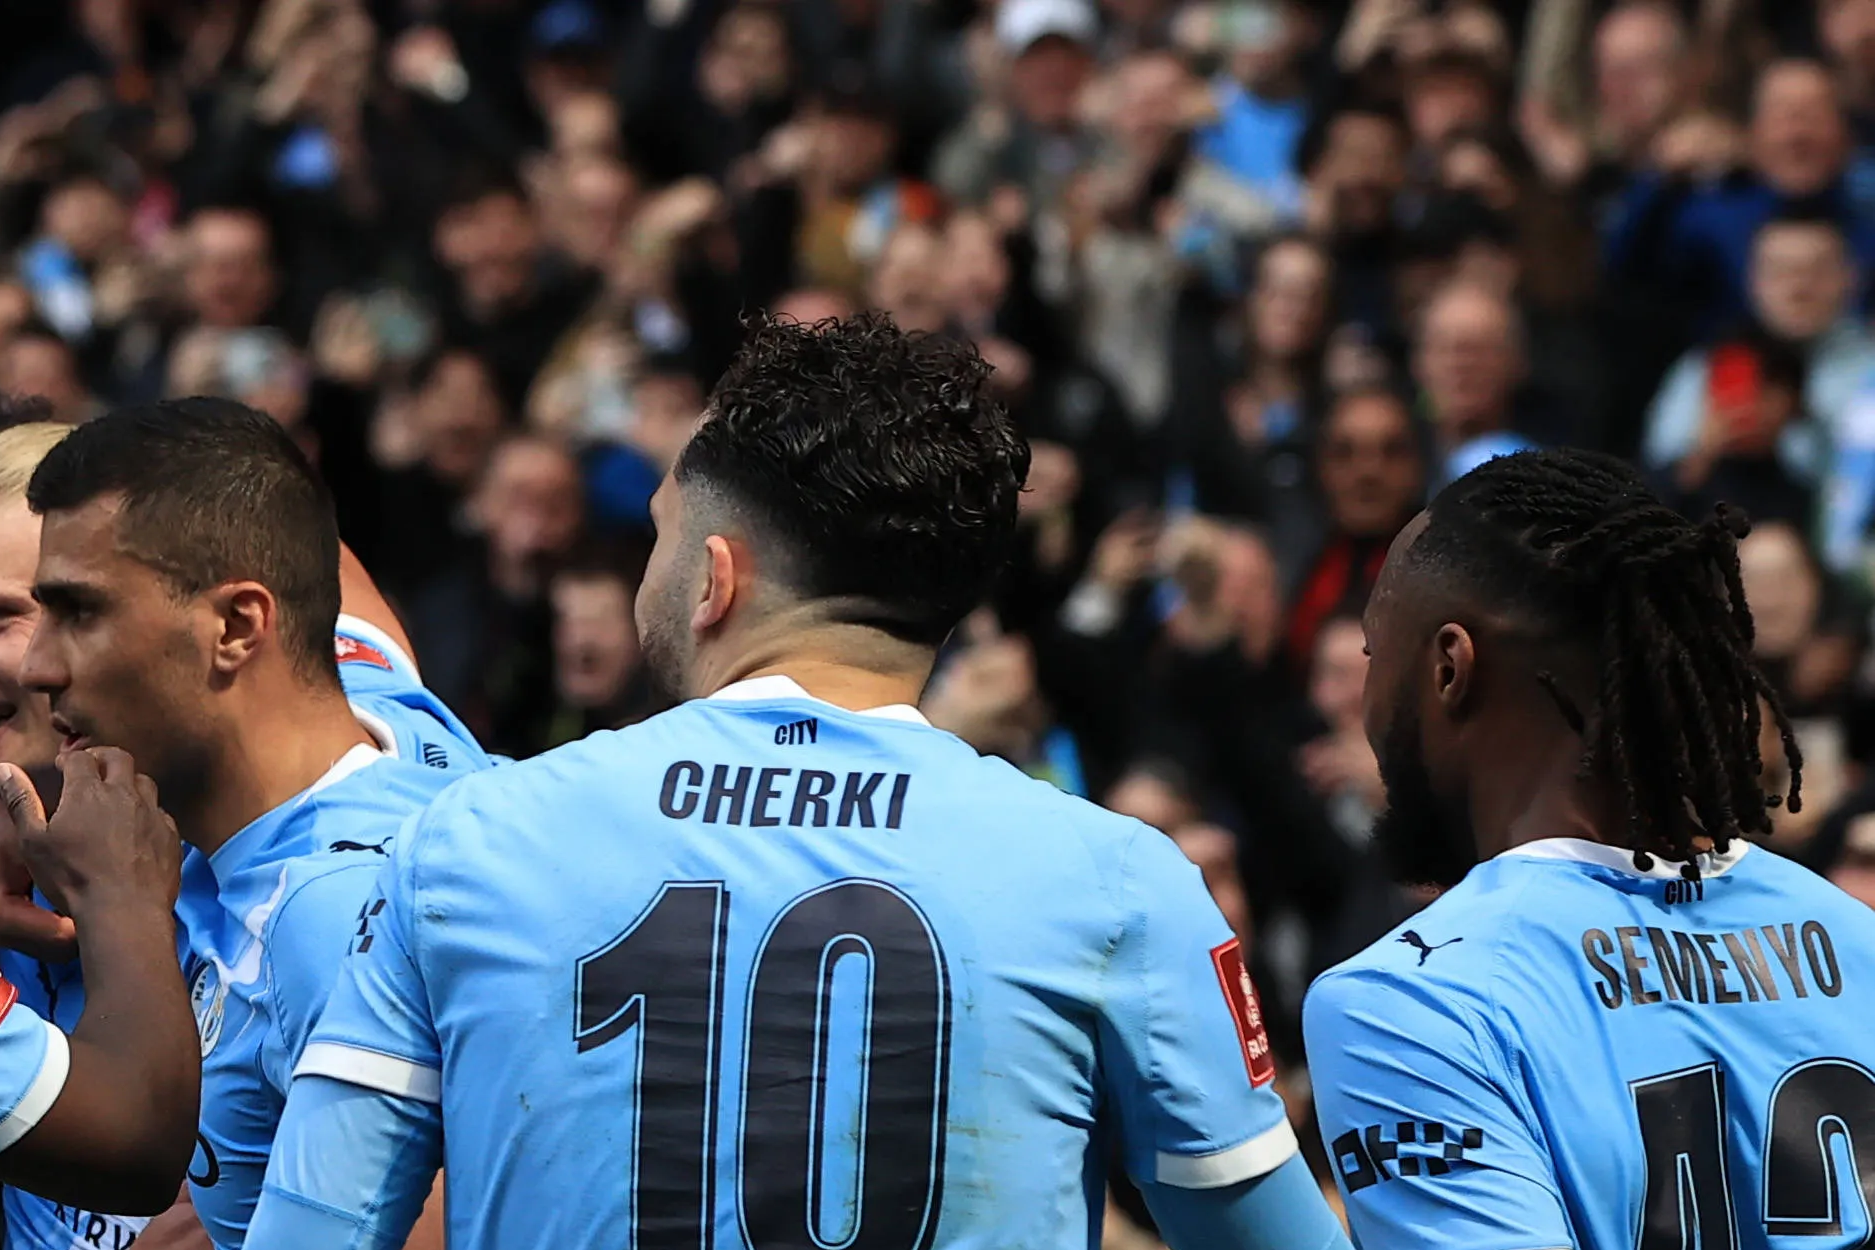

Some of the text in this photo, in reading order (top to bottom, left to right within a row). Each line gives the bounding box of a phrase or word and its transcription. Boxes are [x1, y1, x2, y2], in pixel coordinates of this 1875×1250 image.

[774, 718, 819, 747] CITY
[658, 759, 912, 830] CHERKI
[1582, 919, 1843, 1011] SEMENYO
